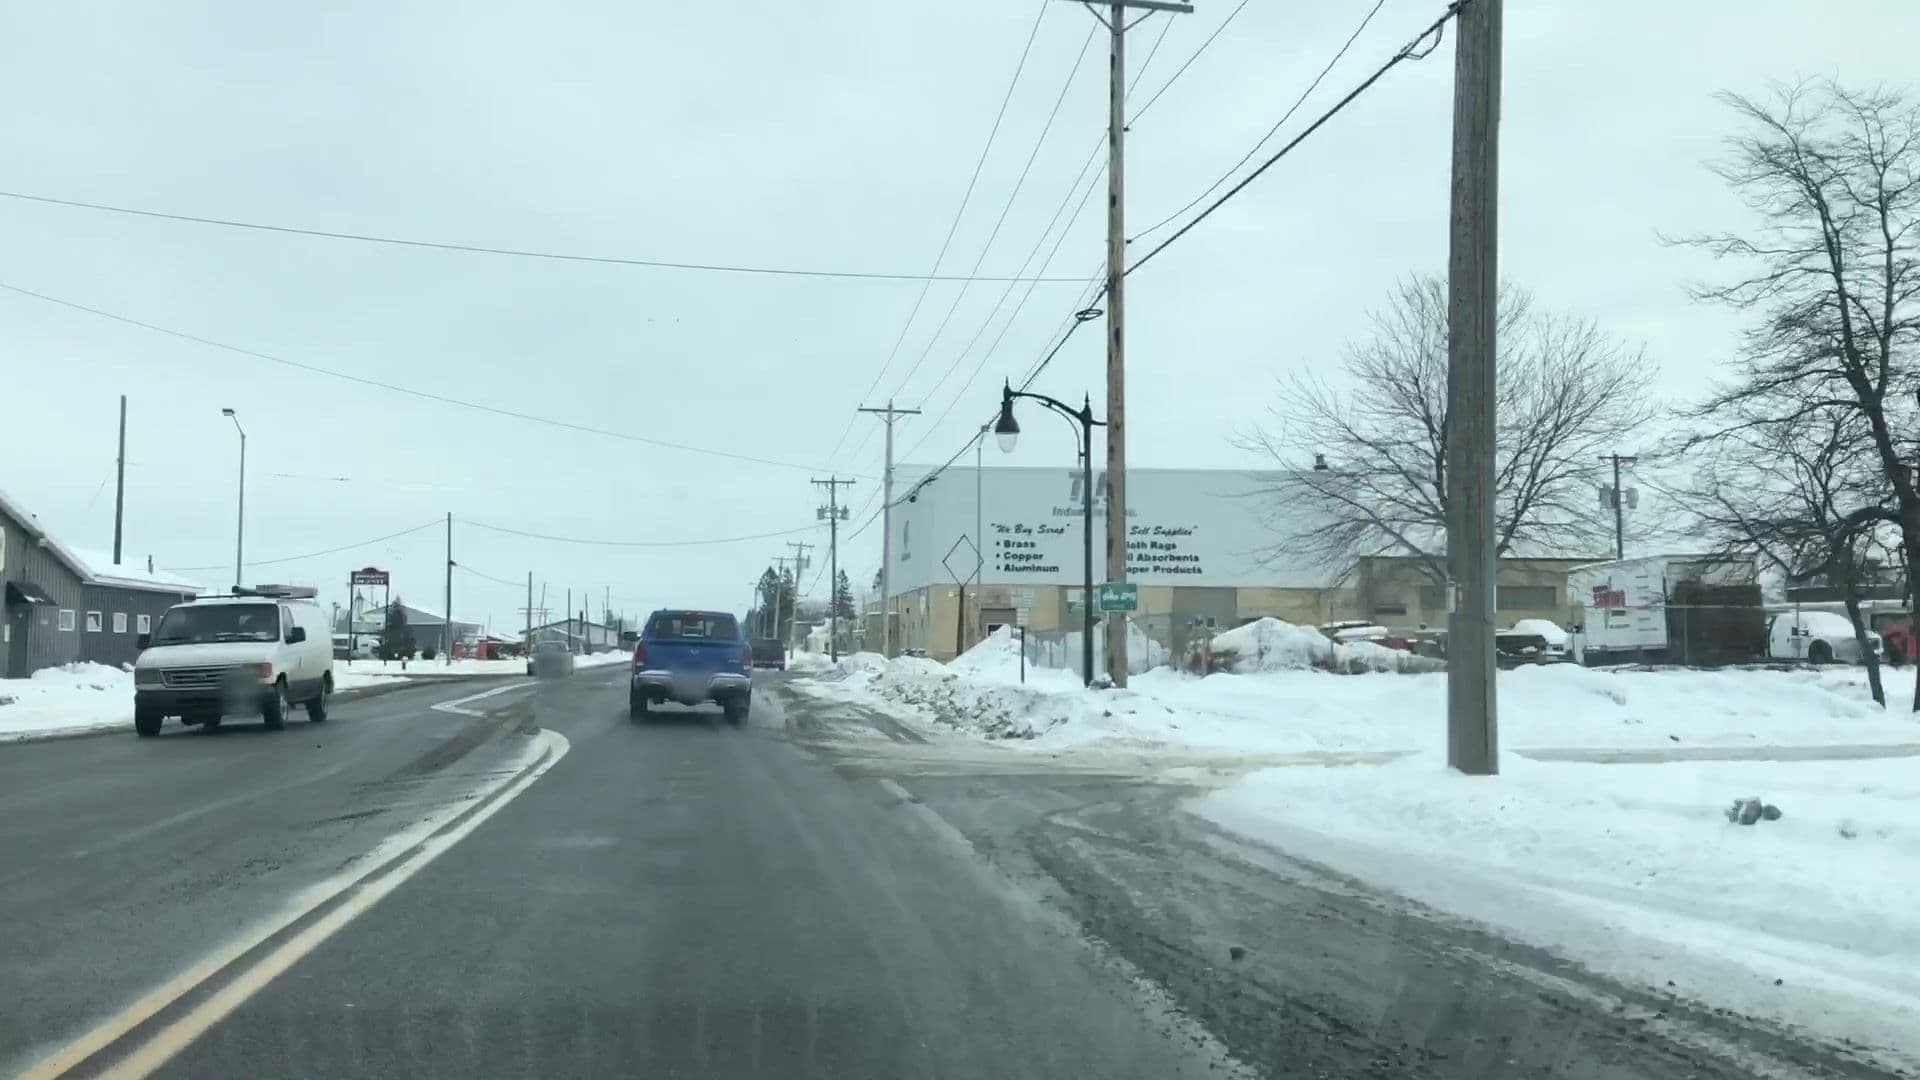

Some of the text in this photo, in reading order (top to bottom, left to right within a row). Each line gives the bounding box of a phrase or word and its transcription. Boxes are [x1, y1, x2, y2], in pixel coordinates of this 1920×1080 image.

[1014, 523, 1032, 536] Buy
[1129, 526, 1150, 535] Sell
[1003, 540, 1036, 548] Brass
[1126, 541, 1177, 550] loth Rags
[1003, 552, 1044, 561] Copper
[1137, 553, 1200, 562] Absorbents
[1003, 563, 1059, 572] Aluminum
[1126, 566, 1202, 575] aper Products
